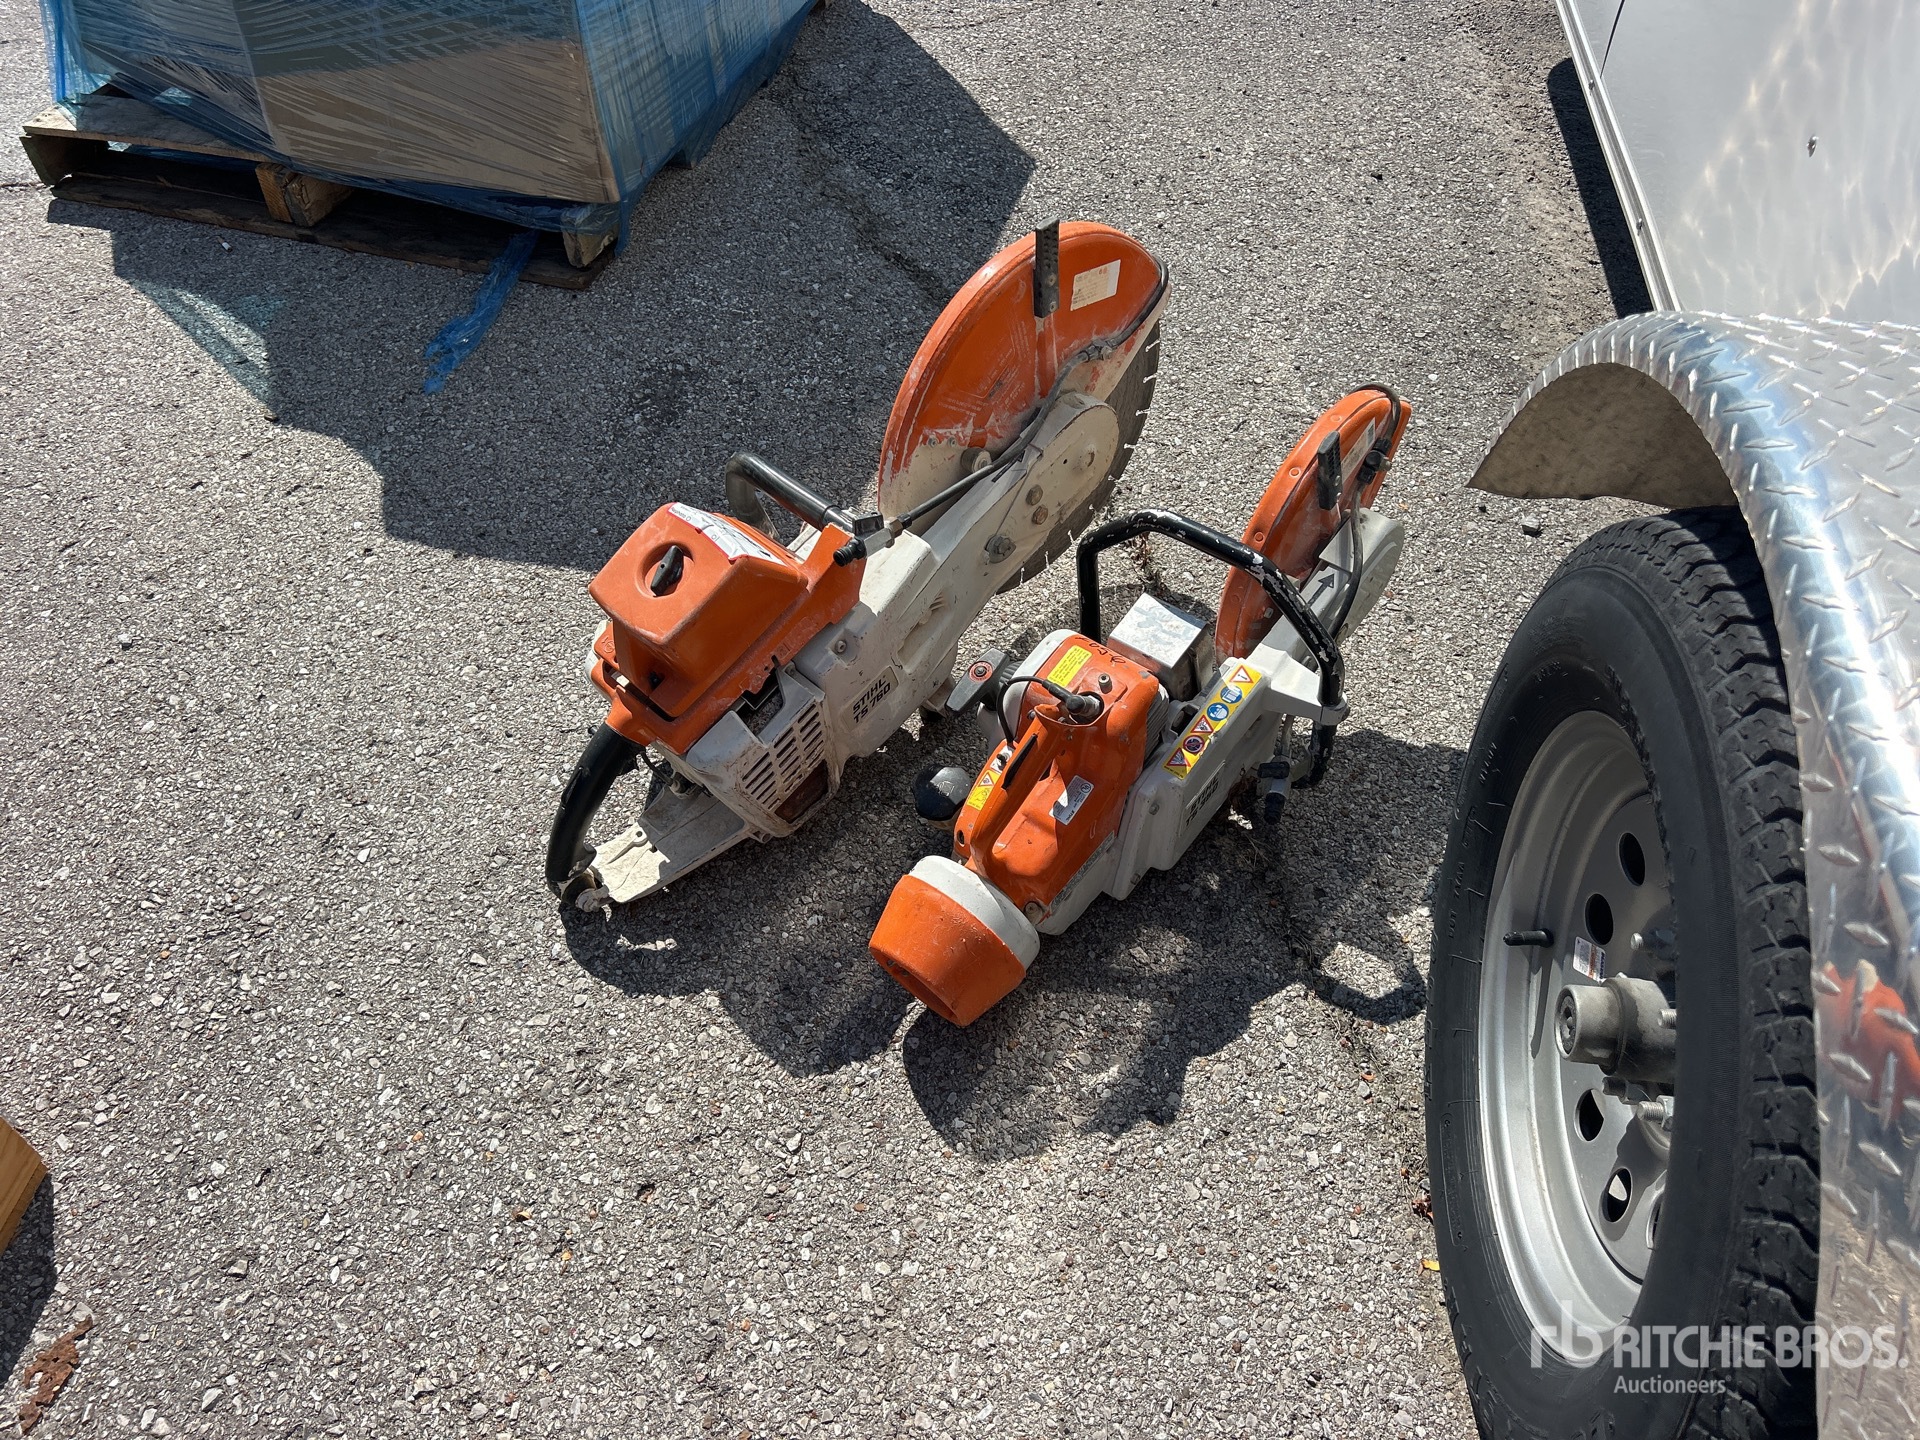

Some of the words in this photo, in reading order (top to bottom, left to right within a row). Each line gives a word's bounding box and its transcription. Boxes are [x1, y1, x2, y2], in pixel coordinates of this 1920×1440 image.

[853, 679, 886, 714] STIHL
[853, 707, 869, 723] TS
[869, 682, 891, 707] 760
[1186, 807, 1198, 826] TS
